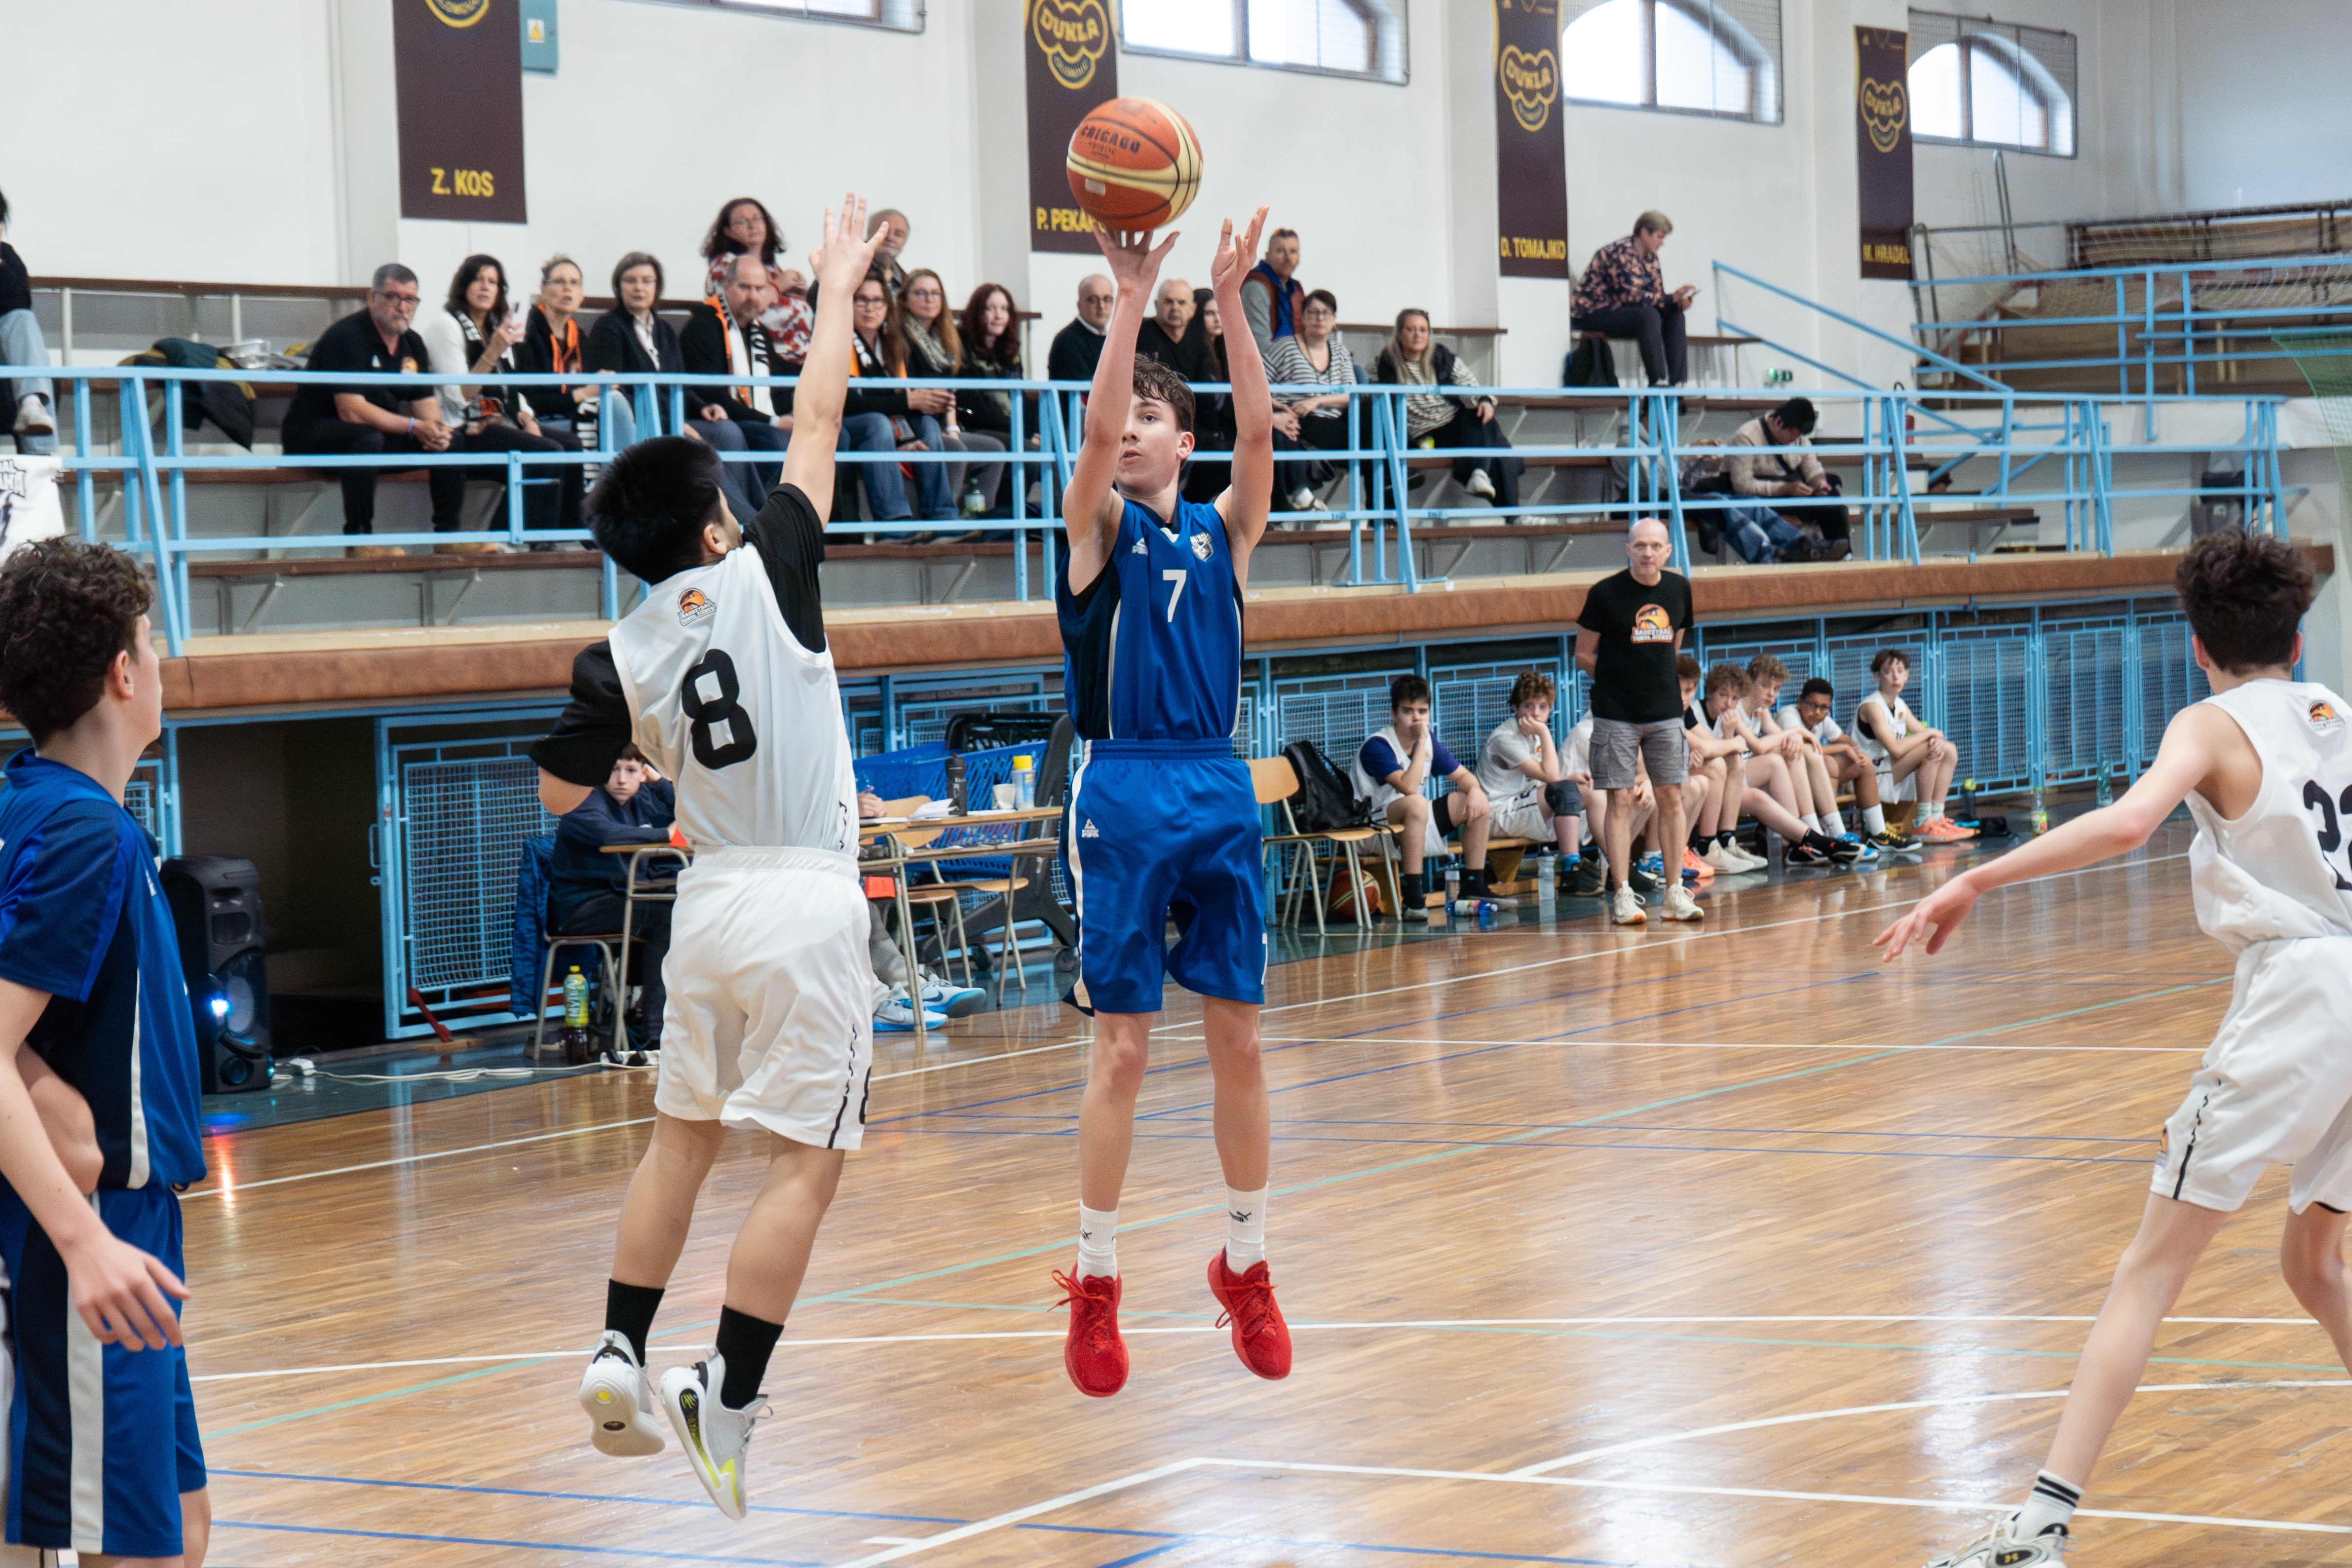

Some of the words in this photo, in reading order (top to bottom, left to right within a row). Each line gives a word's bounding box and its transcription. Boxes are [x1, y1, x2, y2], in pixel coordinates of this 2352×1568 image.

[1081, 125, 1140, 154] CHICAGO
[430, 167, 451, 195] Z.
[454, 168, 494, 197] KOS
[1036, 206, 1049, 230] P.
[1163, 569, 1187, 622] 7
[681, 649, 757, 770] 8
